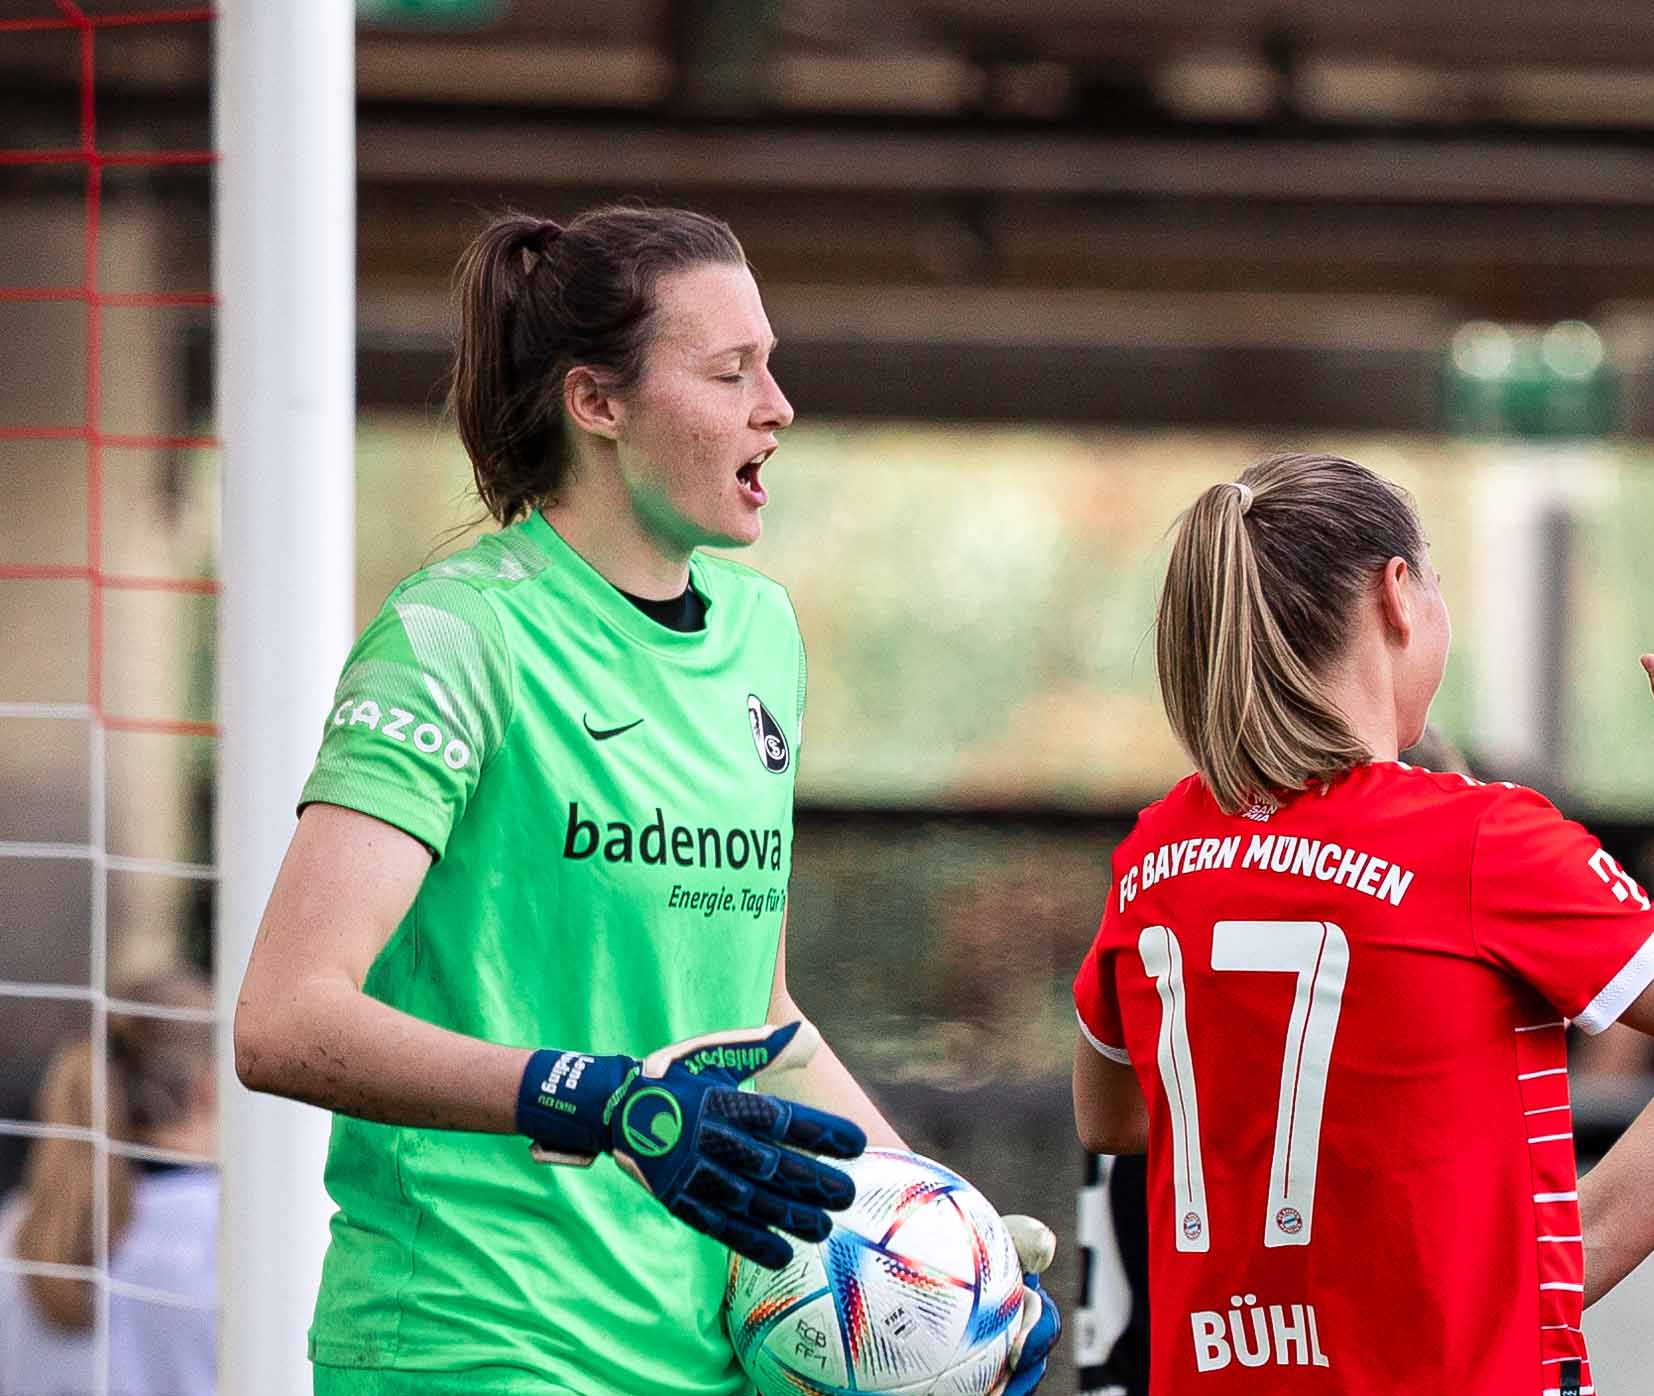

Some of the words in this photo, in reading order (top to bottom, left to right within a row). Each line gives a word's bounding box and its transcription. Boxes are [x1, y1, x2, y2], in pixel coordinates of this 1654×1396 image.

[333, 700, 470, 770] CAZOO
[563, 802, 783, 871] badenova
[1119, 871, 1140, 914] FC
[1141, 835, 1242, 891] BAYERN
[1241, 834, 1415, 907] MÜNCHEN
[668, 885, 736, 918] Energie.
[740, 888, 765, 919] Tag
[1137, 920, 1350, 1253] 17
[1190, 1293, 1330, 1373] BÜHL
